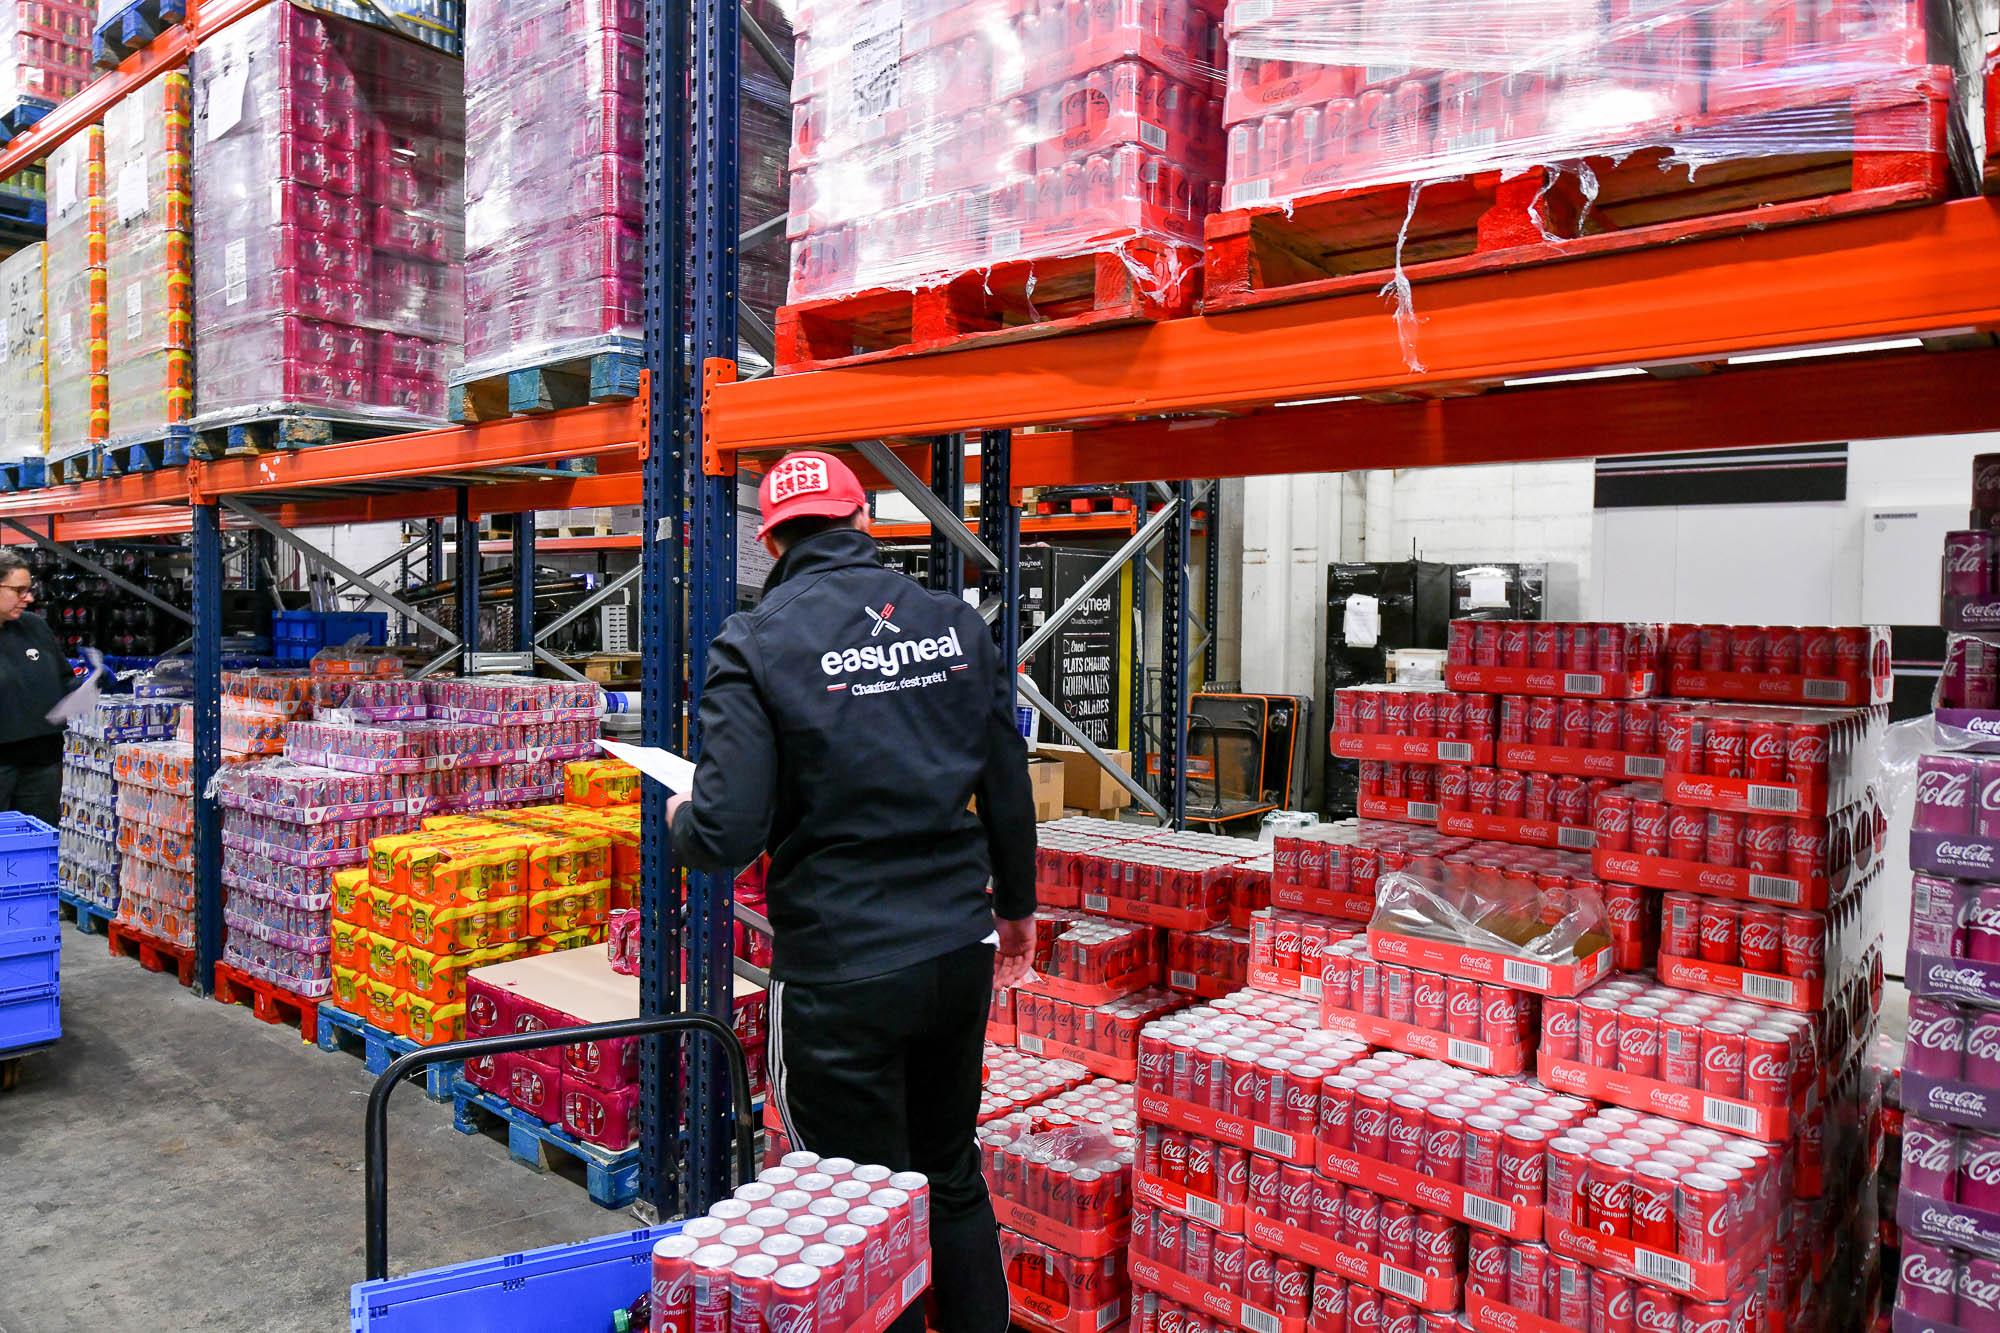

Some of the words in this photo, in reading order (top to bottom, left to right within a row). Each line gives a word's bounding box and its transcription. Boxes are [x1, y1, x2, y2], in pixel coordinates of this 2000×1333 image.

[821, 627, 963, 676] easymeal
[1063, 657, 1083, 673] PLATS
[1085, 656, 1110, 672] CHAUDS
[1063, 675, 1110, 696] GOURMANDS
[1455, 672, 1480, 682] Coca-Cola
[1527, 675, 1555, 686] Coca-Cola
[852, 681, 900, 696] Chauffez,
[1079, 699, 1109, 716] SALADES
[1340, 739, 1364, 749] Coca-Cola
[1404, 743, 1429, 753] Coca-Cola
[1508, 750, 1536, 760] Coca-Cola
[1584, 755, 1615, 767] Coca-Cola
[1677, 782, 1714, 796] Coca-Cola
[1364, 799, 1387, 811] Coca-Cola
[1448, 817, 1474, 829] Coca-Cola
[1520, 825, 1549, 837] Coca-Cola
[1936, 841, 1994, 862] Coca-Cola
[7, 857, 18, 878] K
[1606, 858, 1641, 874] Coca-Cola
[1957, 860, 1990, 869] ORIGINAL
[1699, 872, 1737, 887] Coca-Cola
[1280, 889, 1304, 900] Coca-Cola
[1345, 899, 1371, 911] Coca-Cola
[8, 905, 21, 926] K
[1378, 938, 1409, 953] Coca-Cola
[1460, 954, 1493, 970] Coca-Cola
[1672, 965, 1710, 981] Coca-Cola
[1929, 965, 1987, 986] Coca-Cola
[1328, 1013, 1358, 1029] Coca-Cola
[1407, 1031, 1438, 1048] Coca-Cola
[1552, 1066, 1588, 1083] Coca-Cola
[1143, 1097, 1169, 1113] Coca-Cola
[1650, 1088, 1690, 1108] Coca-Cola
[1929, 1086, 1987, 1111] Coca-Cola
[1950, 1106, 1982, 1118] ORIGINAL
[1216, 1118, 1244, 1136] Coca-Cola
[1328, 1154, 1360, 1174] Coca-Cola
[1138, 1178, 1163, 1196] Coca-Cola
[1416, 1182, 1452, 1203] Coca-Cola
[1922, 1208, 1978, 1235] Coca-Cola
[1255, 1222, 1284, 1242] Coca-Cola
[1559, 1230, 1599, 1253] Coca-Cola
[1135, 1261, 1160, 1280] Coca-Cola
[1336, 1252, 1369, 1273] Coca-Cola
[1024, 1295, 1052, 1316] Coca-Cola
[1204, 1291, 1232, 1312] Coca-Cola
[1481, 1305, 1518, 1328] Coca-Cola
